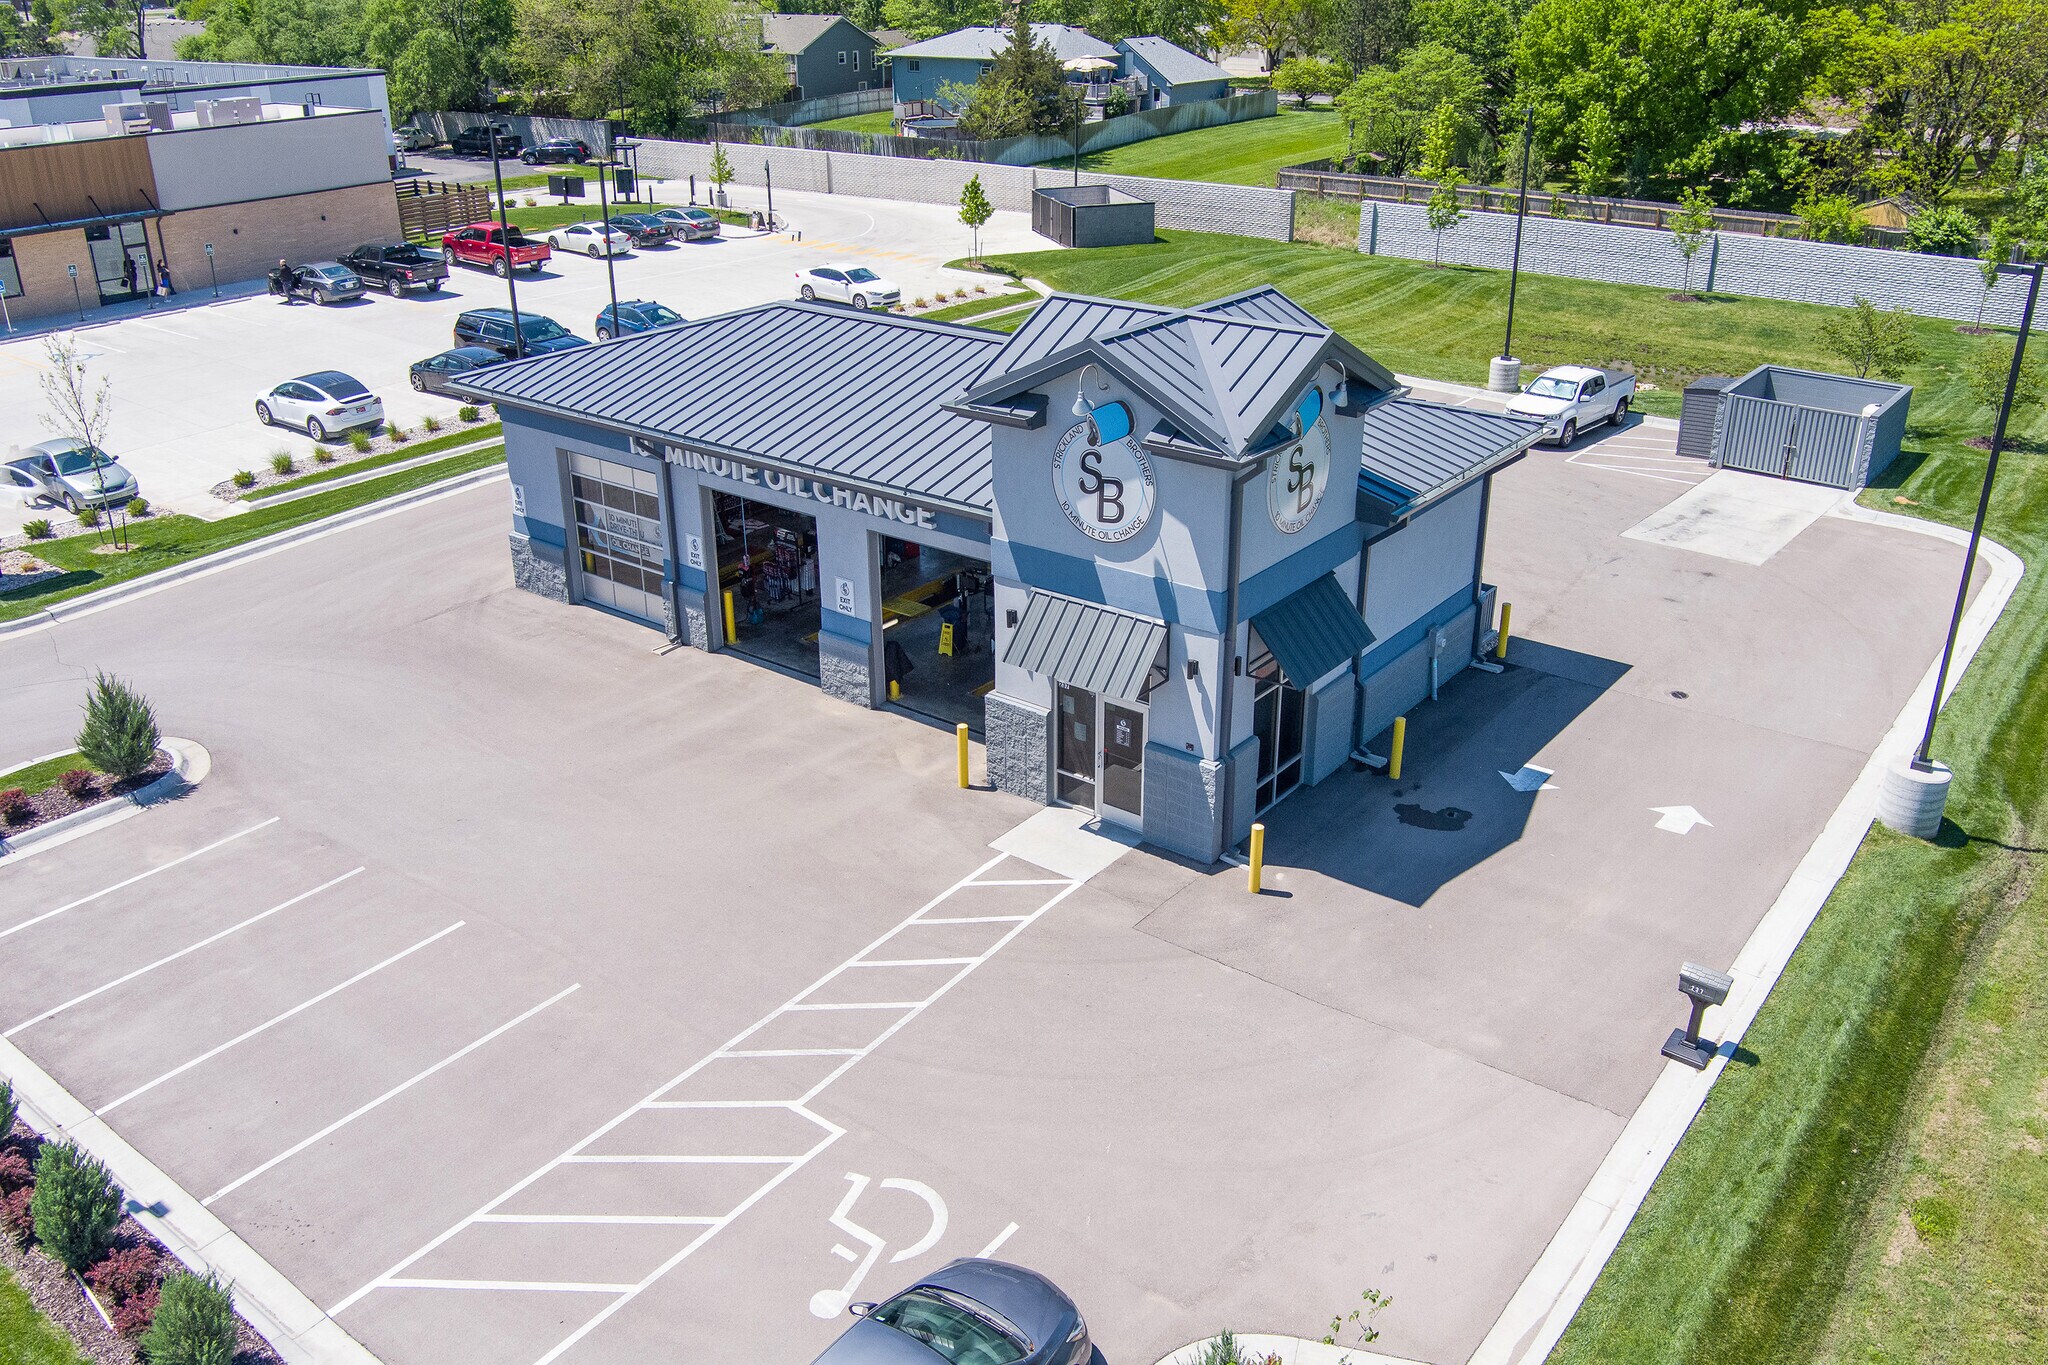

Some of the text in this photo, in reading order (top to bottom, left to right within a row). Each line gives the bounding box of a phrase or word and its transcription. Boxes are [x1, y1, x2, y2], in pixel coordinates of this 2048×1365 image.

[1053, 425, 1154, 487] STRICKLAND BROTHERS
[764, 470, 813, 499] OIL
[812, 482, 938, 530] CHANGE
[1061, 500, 1140, 541] 10 MINUTE OIL CHANGE
